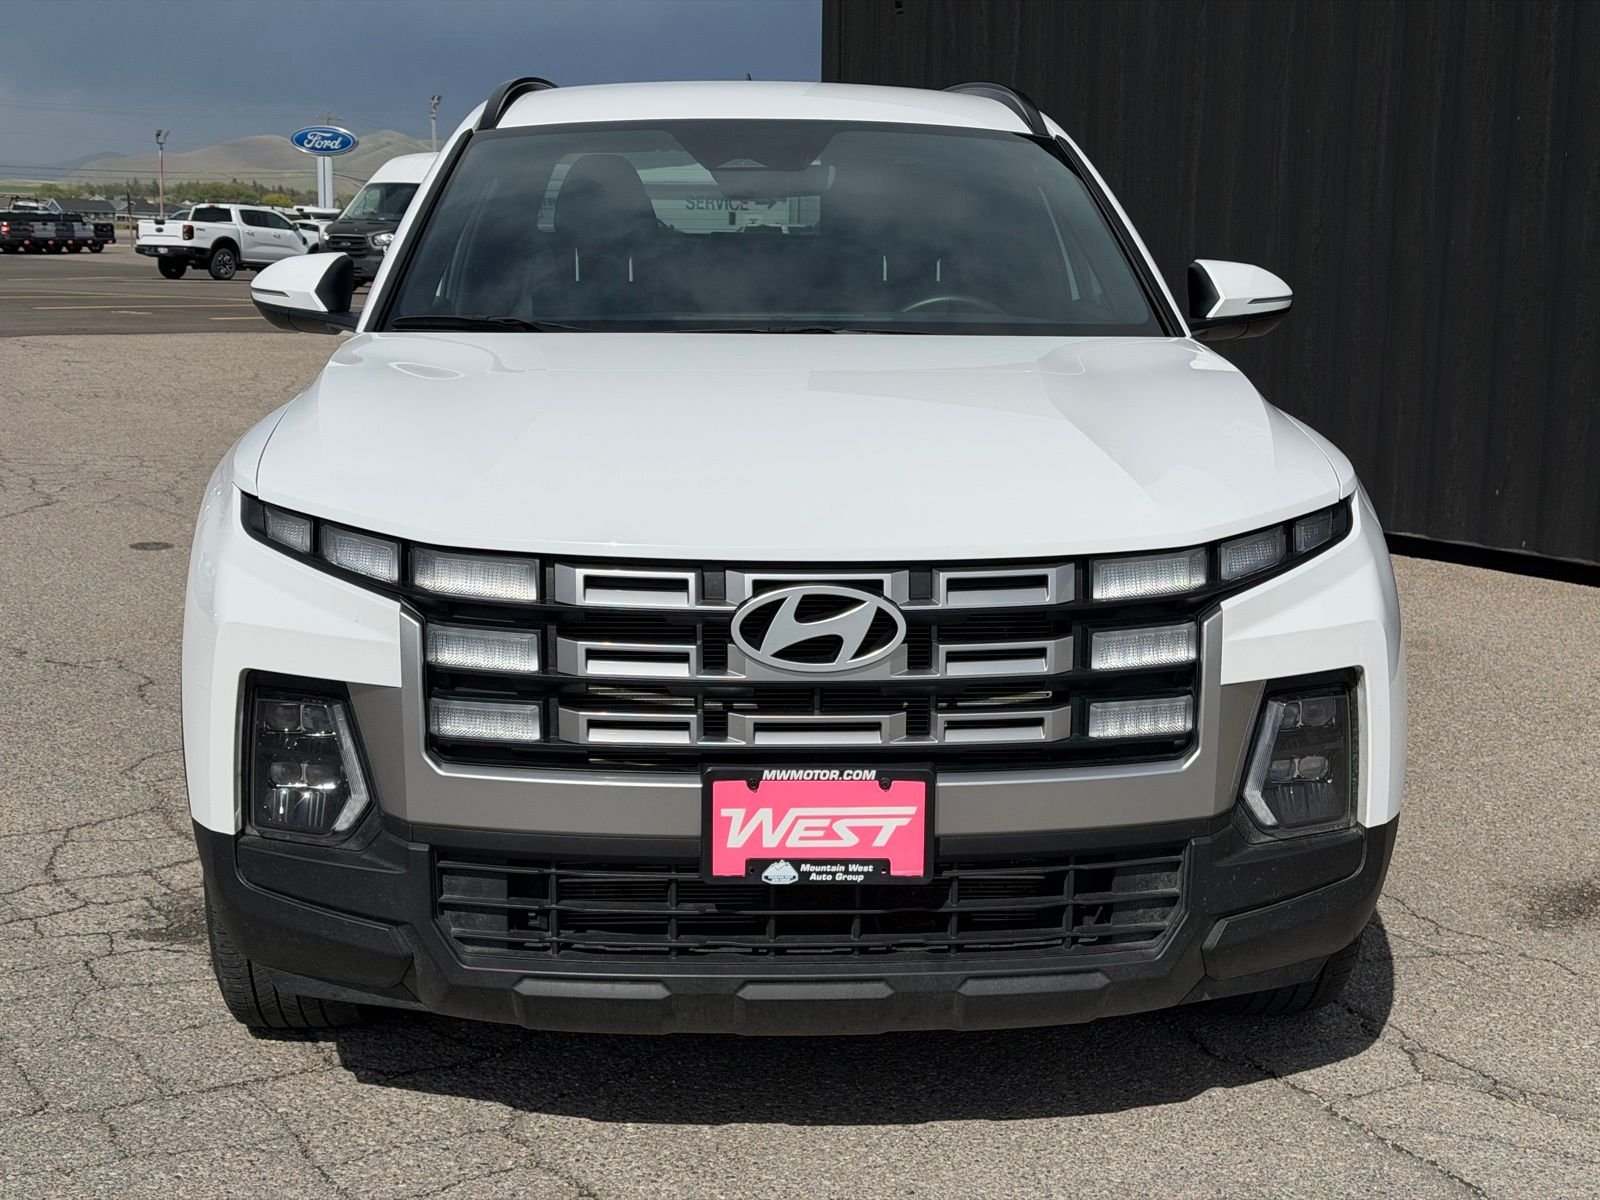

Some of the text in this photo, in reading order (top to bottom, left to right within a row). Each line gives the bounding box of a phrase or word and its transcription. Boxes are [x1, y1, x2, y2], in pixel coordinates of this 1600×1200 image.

[303, 131, 343, 150] Ford
[685, 195, 749, 211] SERVICE
[762, 769, 877, 781] MWMOTOR.COM
[720, 806, 917, 848] WEST
[800, 863, 874, 872] Mountain West
[809, 872, 864, 883] Auto Group
